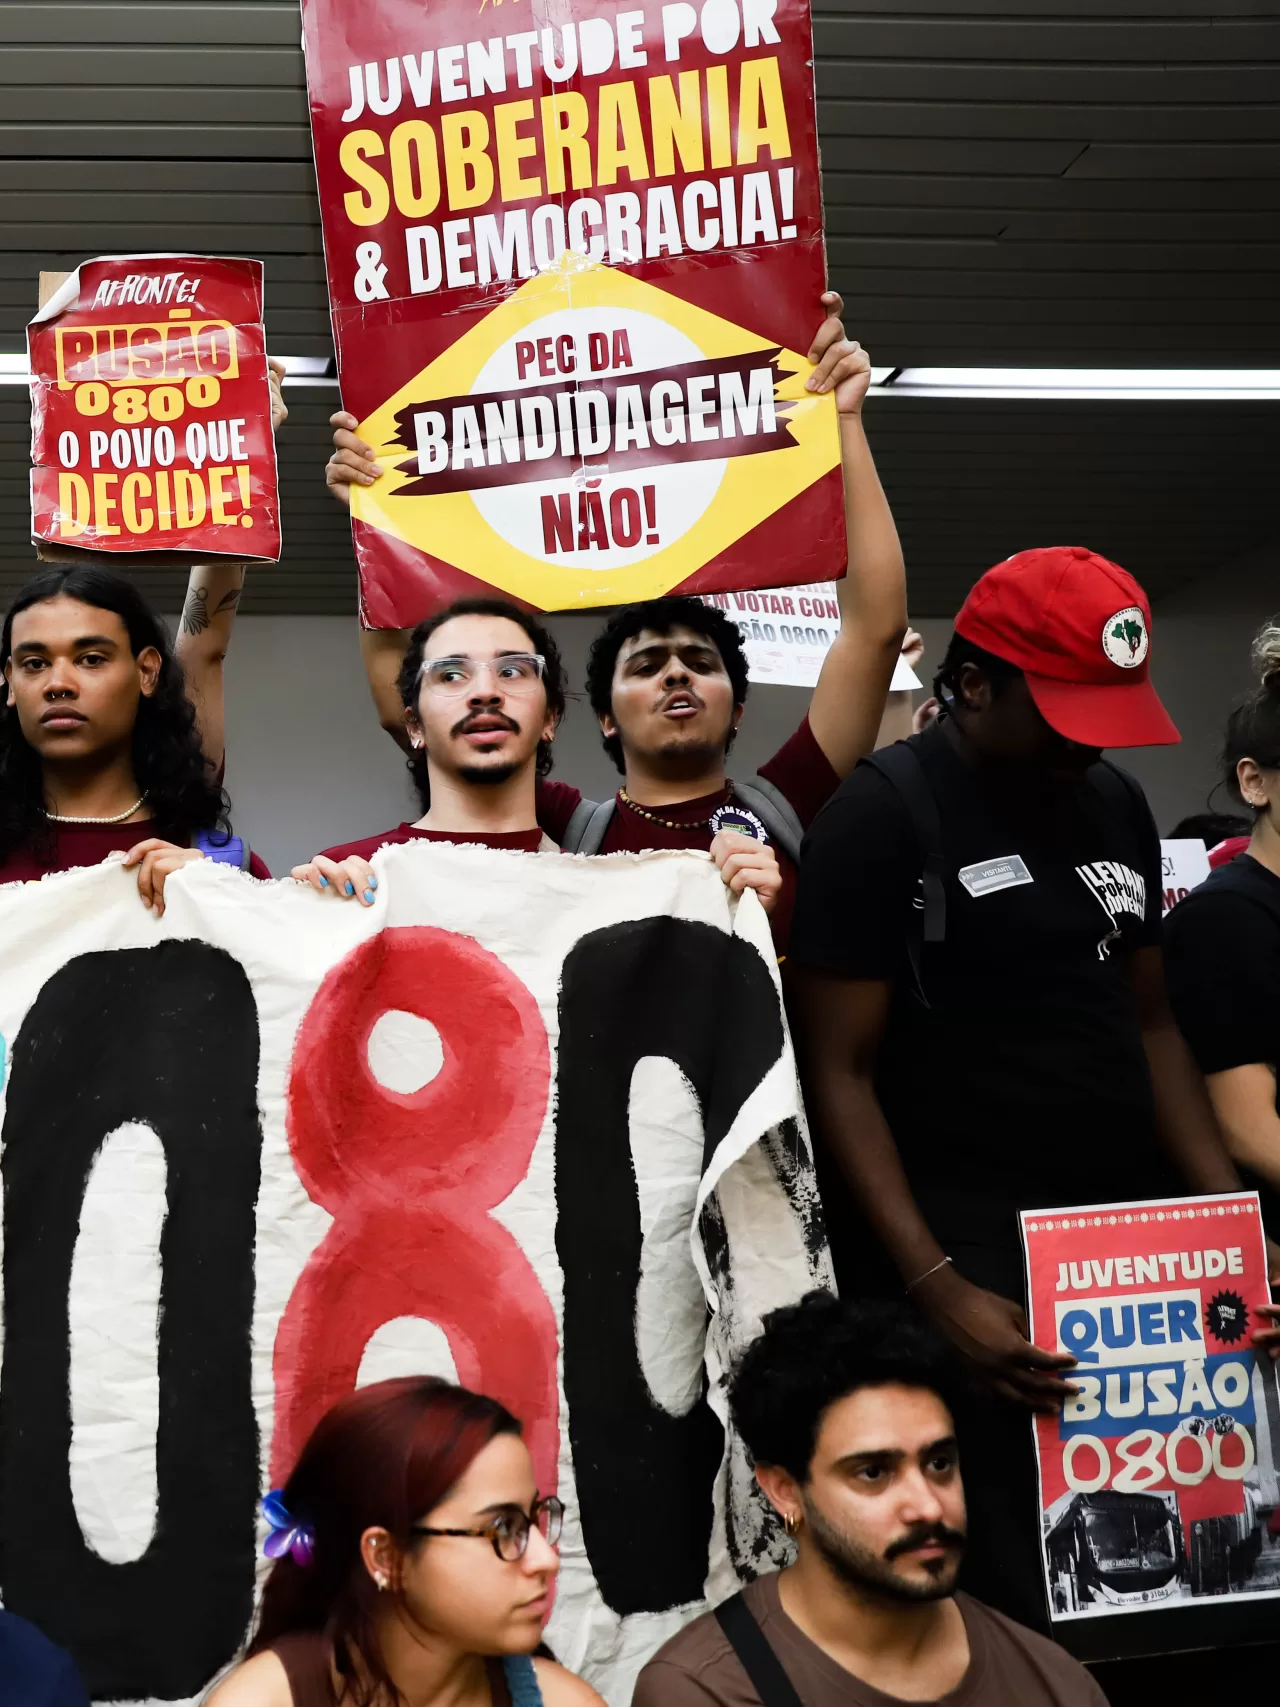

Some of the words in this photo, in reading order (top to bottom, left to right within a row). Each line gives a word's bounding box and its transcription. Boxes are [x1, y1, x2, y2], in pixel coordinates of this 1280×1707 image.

[341, 10, 648, 122] JUVENTUDE
[663, 0, 782, 59] POR
[338, 55, 793, 227] SOBERANIA
[353, 240, 390, 303] &
[405, 167, 798, 295] DEMOCRACIA!
[91, 272, 201, 310] AFRONTE!
[62, 308, 231, 382] BUSÃO
[515, 333, 577, 381] PEC
[588, 327, 633, 372] DA
[75, 375, 221, 424] 0800
[414, 367, 779, 475] BANDIDAGEM
[58, 430, 80, 468] O
[90, 426, 176, 469] POVO
[185, 418, 249, 470] QUE
[58, 465, 253, 537] DECIDE!
[540, 477, 660, 555] NÃO!
[734, 592, 796, 616] VOTAR
[780, 625, 831, 646] 0800
[981, 865, 1012, 877] VISITANTE
[1055, 1247, 1244, 1292] JUVENTUDE
[1060, 1299, 1203, 1364] QUER
[1063, 1358, 1250, 1423] BUSÃO
[1062, 1422, 1255, 1493] 0800
